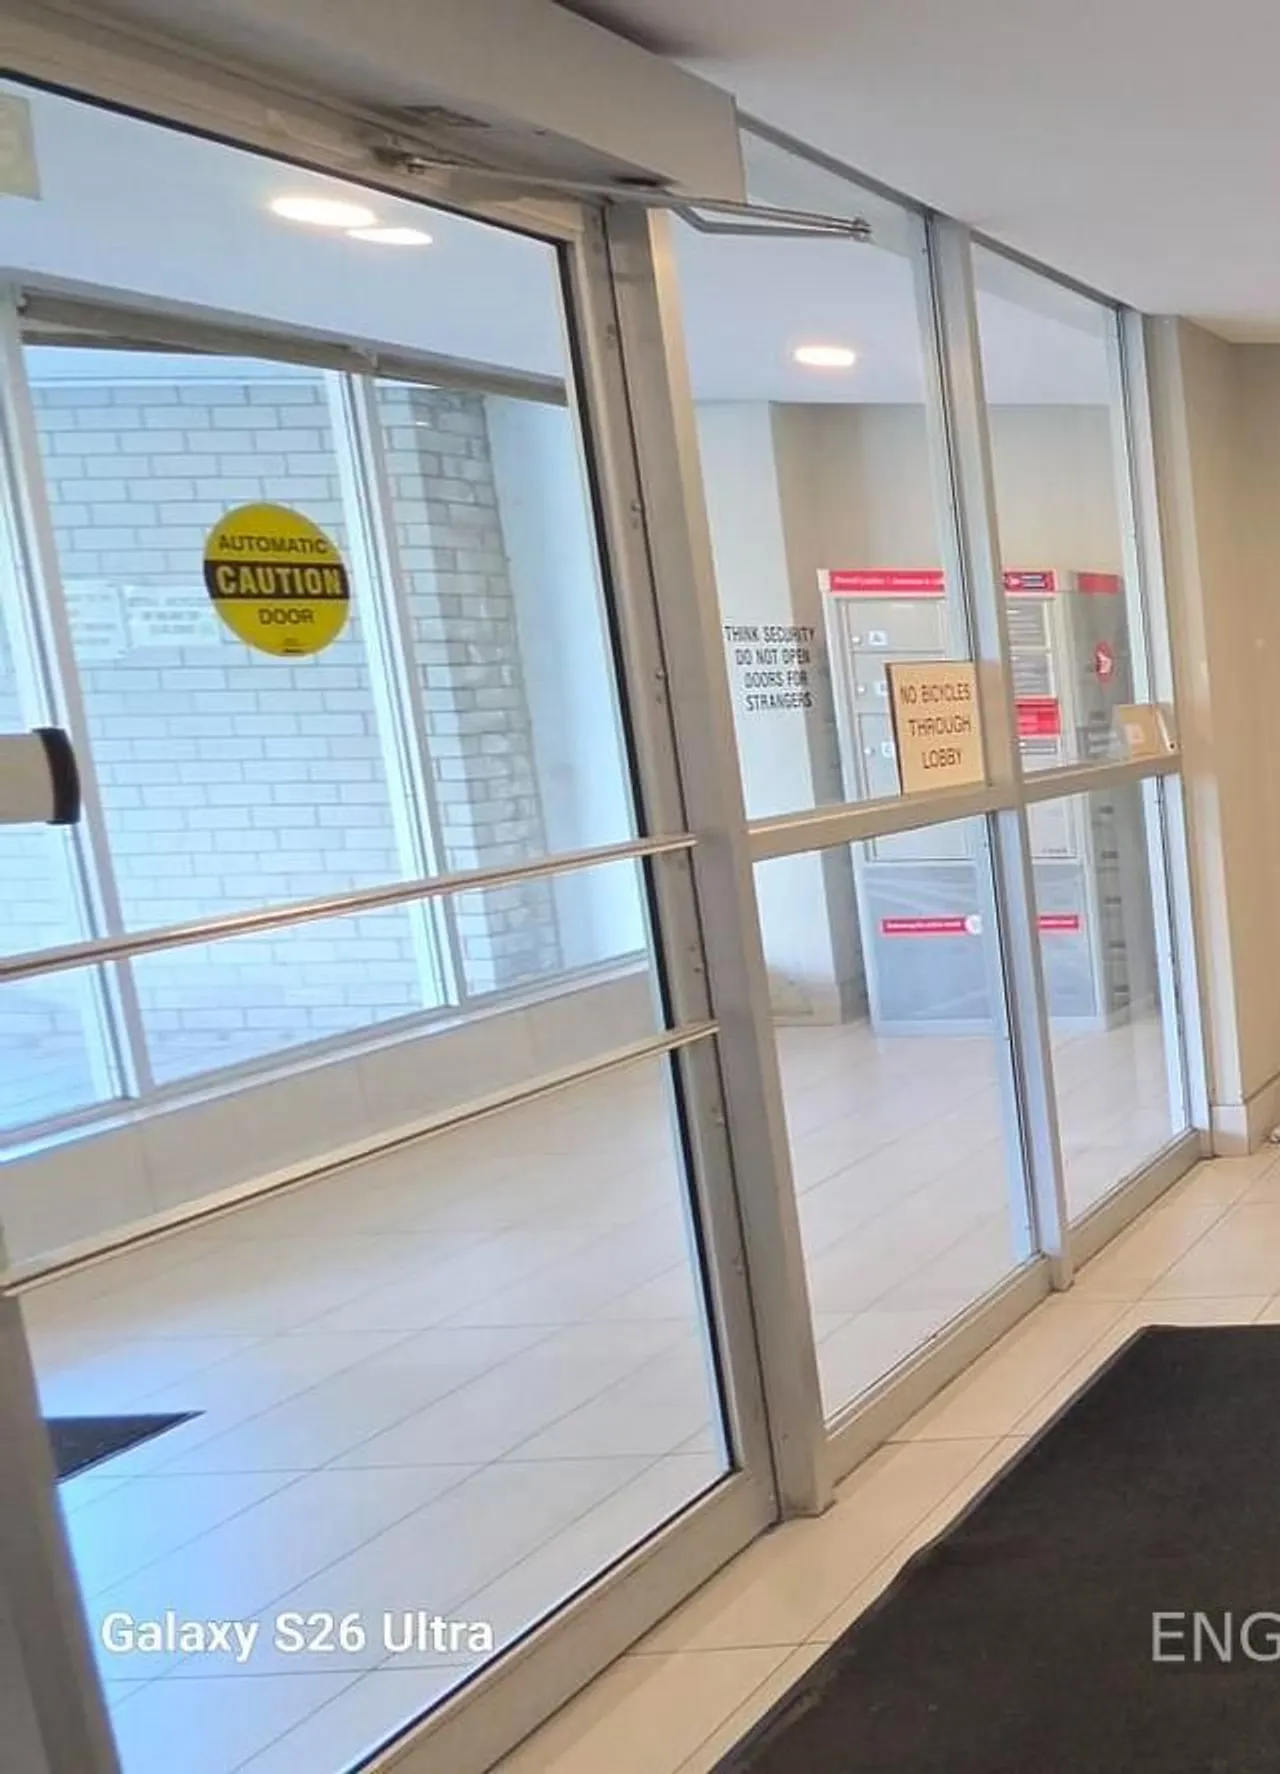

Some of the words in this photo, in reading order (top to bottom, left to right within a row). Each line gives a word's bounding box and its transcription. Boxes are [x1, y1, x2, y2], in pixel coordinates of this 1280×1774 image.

[218, 534, 329, 555] AUTOMATIC
[215, 565, 343, 595] CAUTION
[258, 608, 315, 625] DOOR
[724, 626, 759, 642] THINK
[764, 625, 815, 643] SECURITY
[735, 648, 753, 665] DO
[756, 648, 778, 665] NOT
[782, 647, 810, 665] OPEN
[744, 671, 784, 689] DOORS
[787, 670, 808, 686] FOR
[746, 691, 813, 711] STRANGERS
[921, 682, 971, 703] BICYCLES
[908, 714, 972, 738] THROUGH
[922, 747, 962, 769] LOBBY
